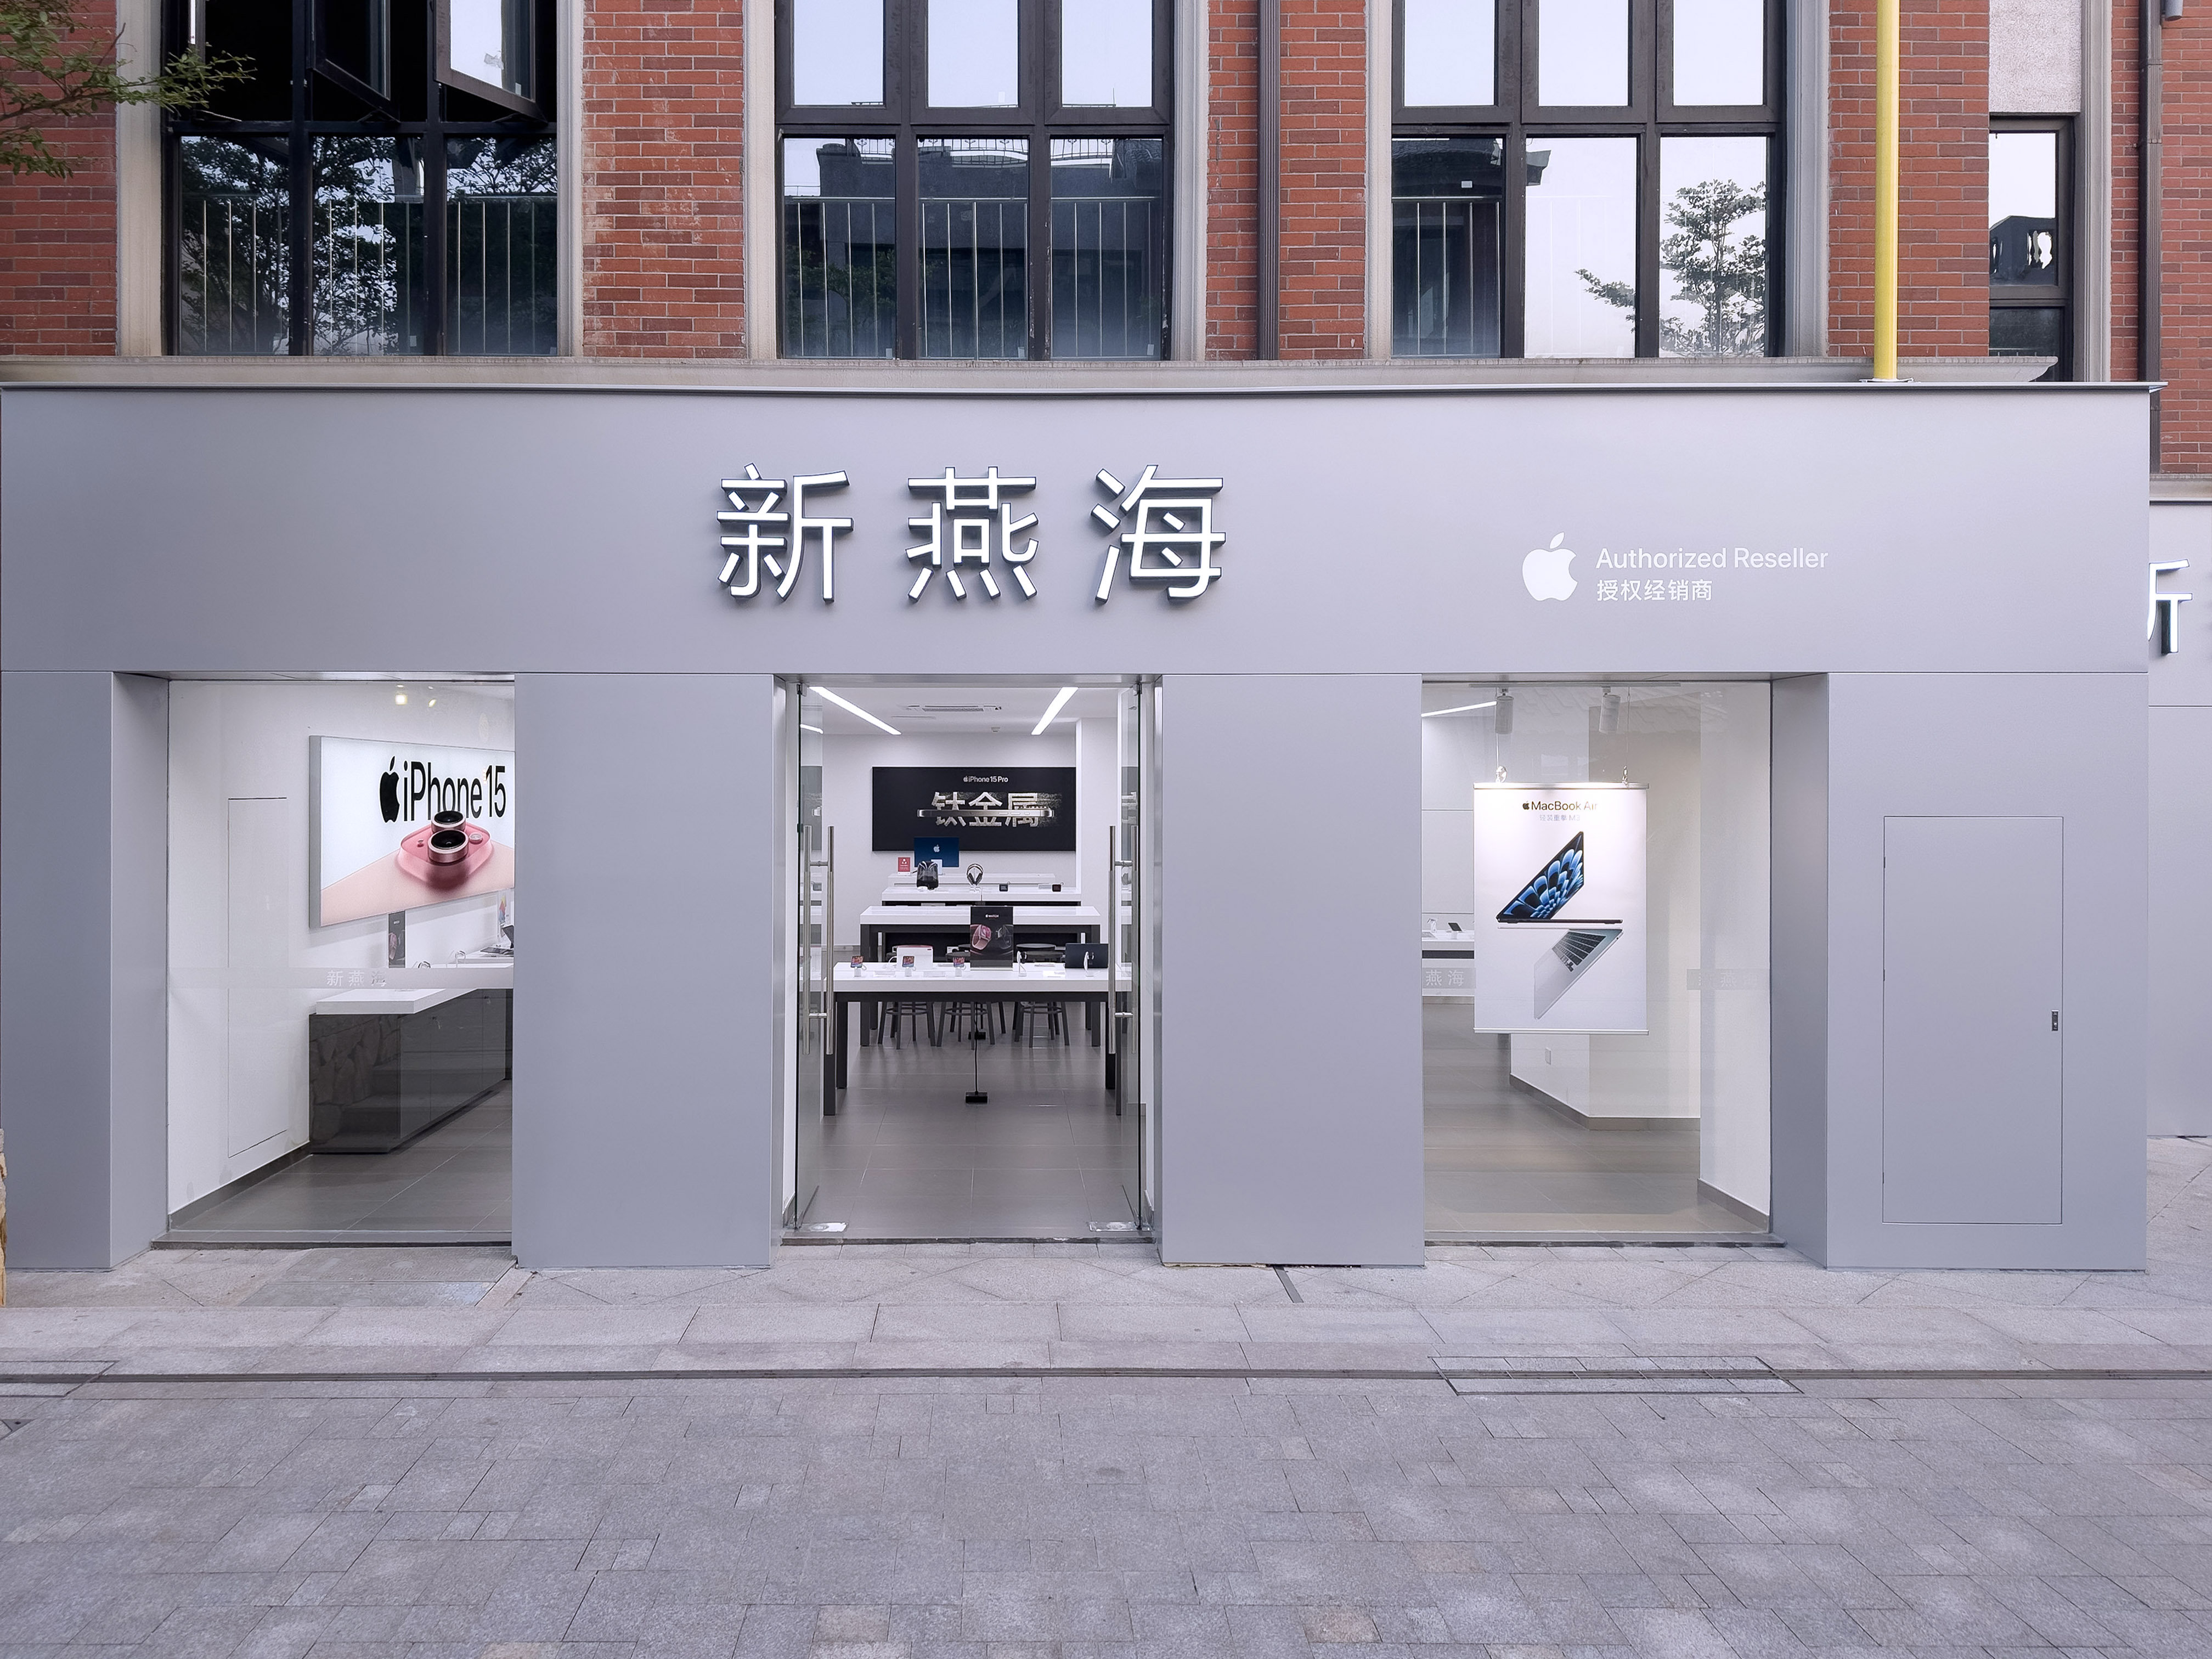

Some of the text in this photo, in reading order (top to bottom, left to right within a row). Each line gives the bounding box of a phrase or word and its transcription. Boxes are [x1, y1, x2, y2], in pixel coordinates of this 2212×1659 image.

[716, 462, 1227, 603] 新燕海
[1596, 547, 1829, 568] Authorized Reseller
[1597, 579, 1713, 601] 授权经销商
[404, 760, 506, 821] iPhone 15
[932, 792, 1039, 827] 钛金属
[1531, 801, 1598, 810] MacBook Air
[326, 970, 387, 987] 新燕海
[1425, 969, 1464, 986] 燕海
